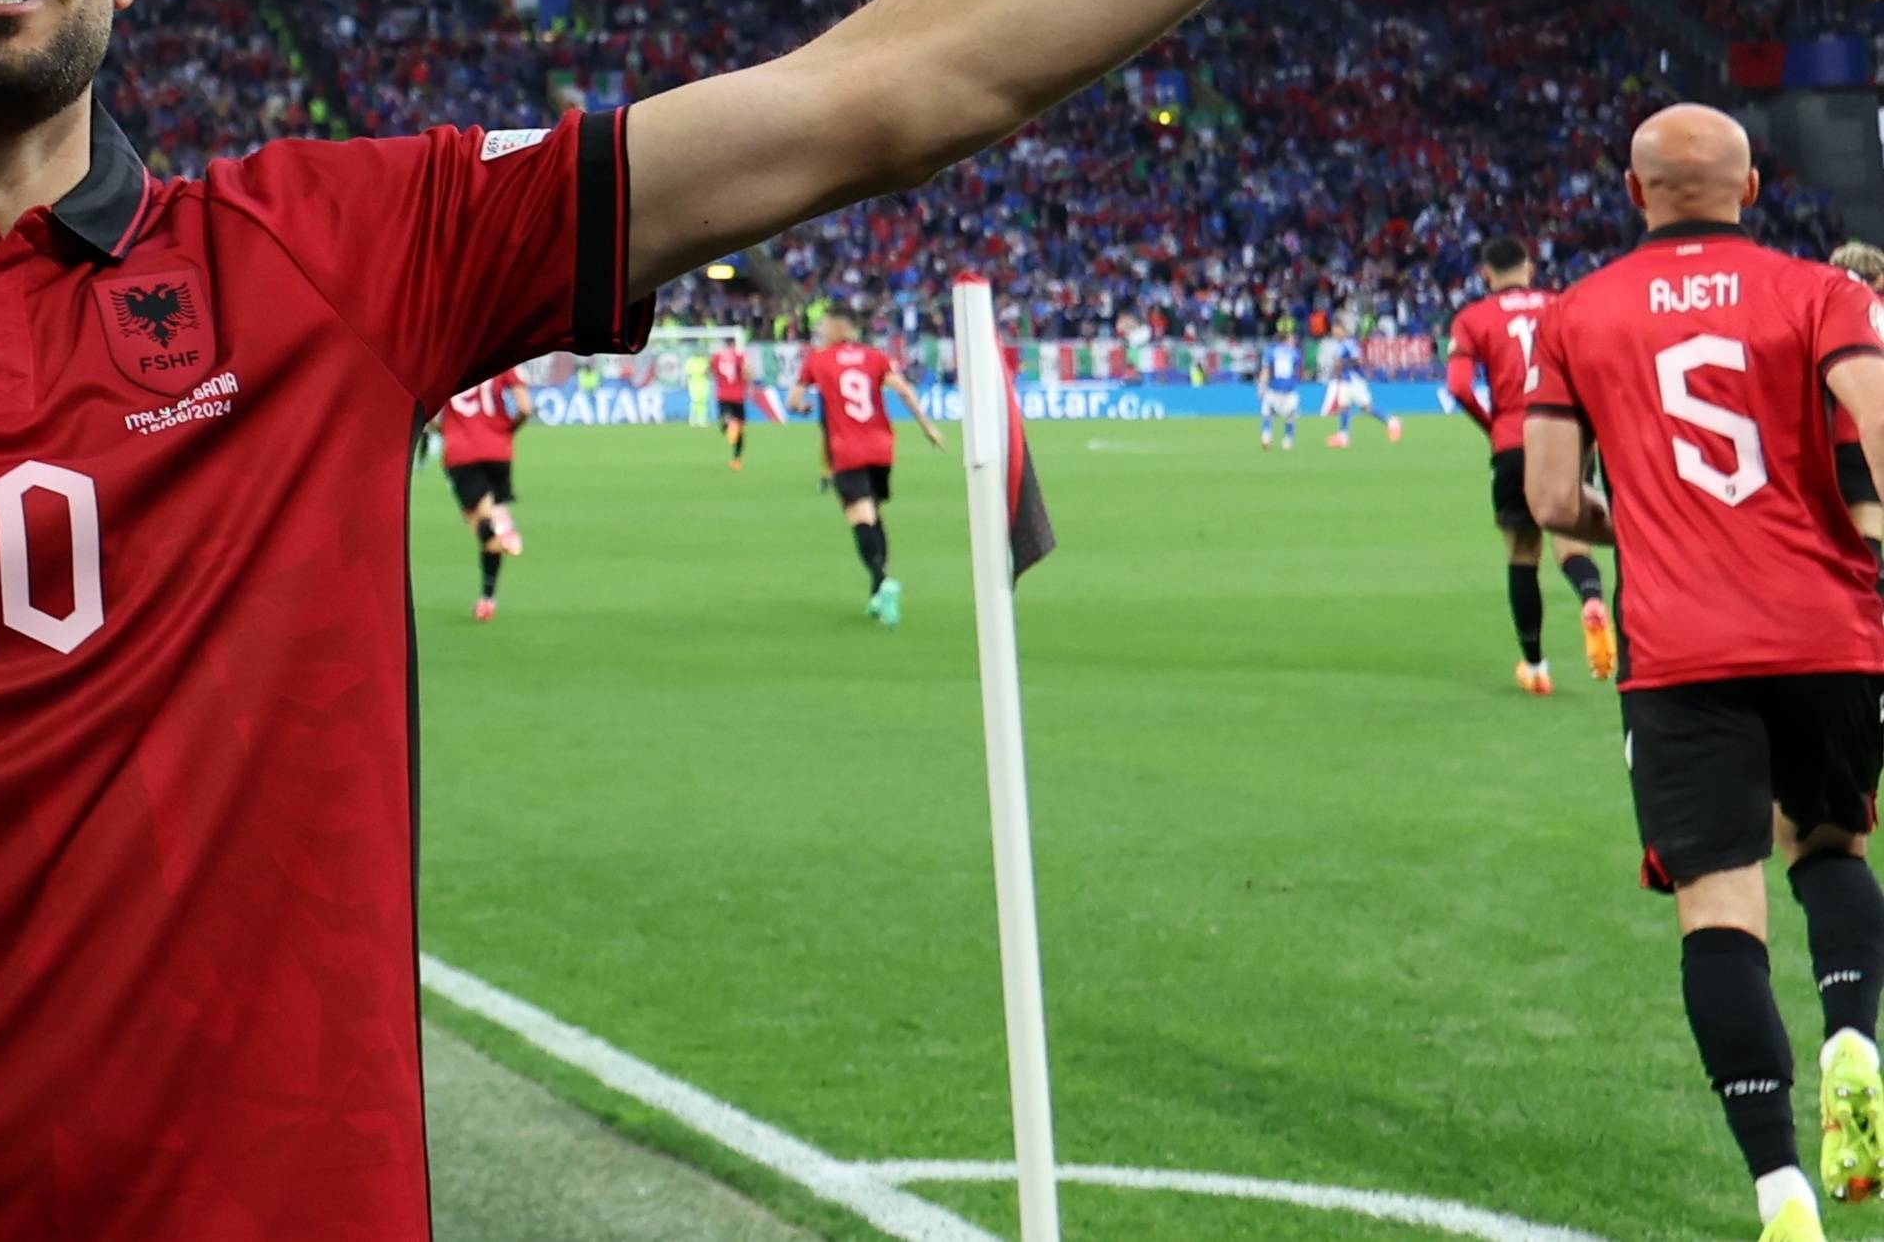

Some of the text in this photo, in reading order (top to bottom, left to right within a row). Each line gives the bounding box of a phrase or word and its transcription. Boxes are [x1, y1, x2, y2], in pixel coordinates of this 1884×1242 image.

[1648, 272, 1739, 314] AJETI
[139, 349, 200, 374] FSHF
[534, 386, 665, 427] QATAR
[839, 368, 875, 423] 9
[138, 399, 232, 435] 15/06/2024
[1656, 333, 1768, 507] 5
